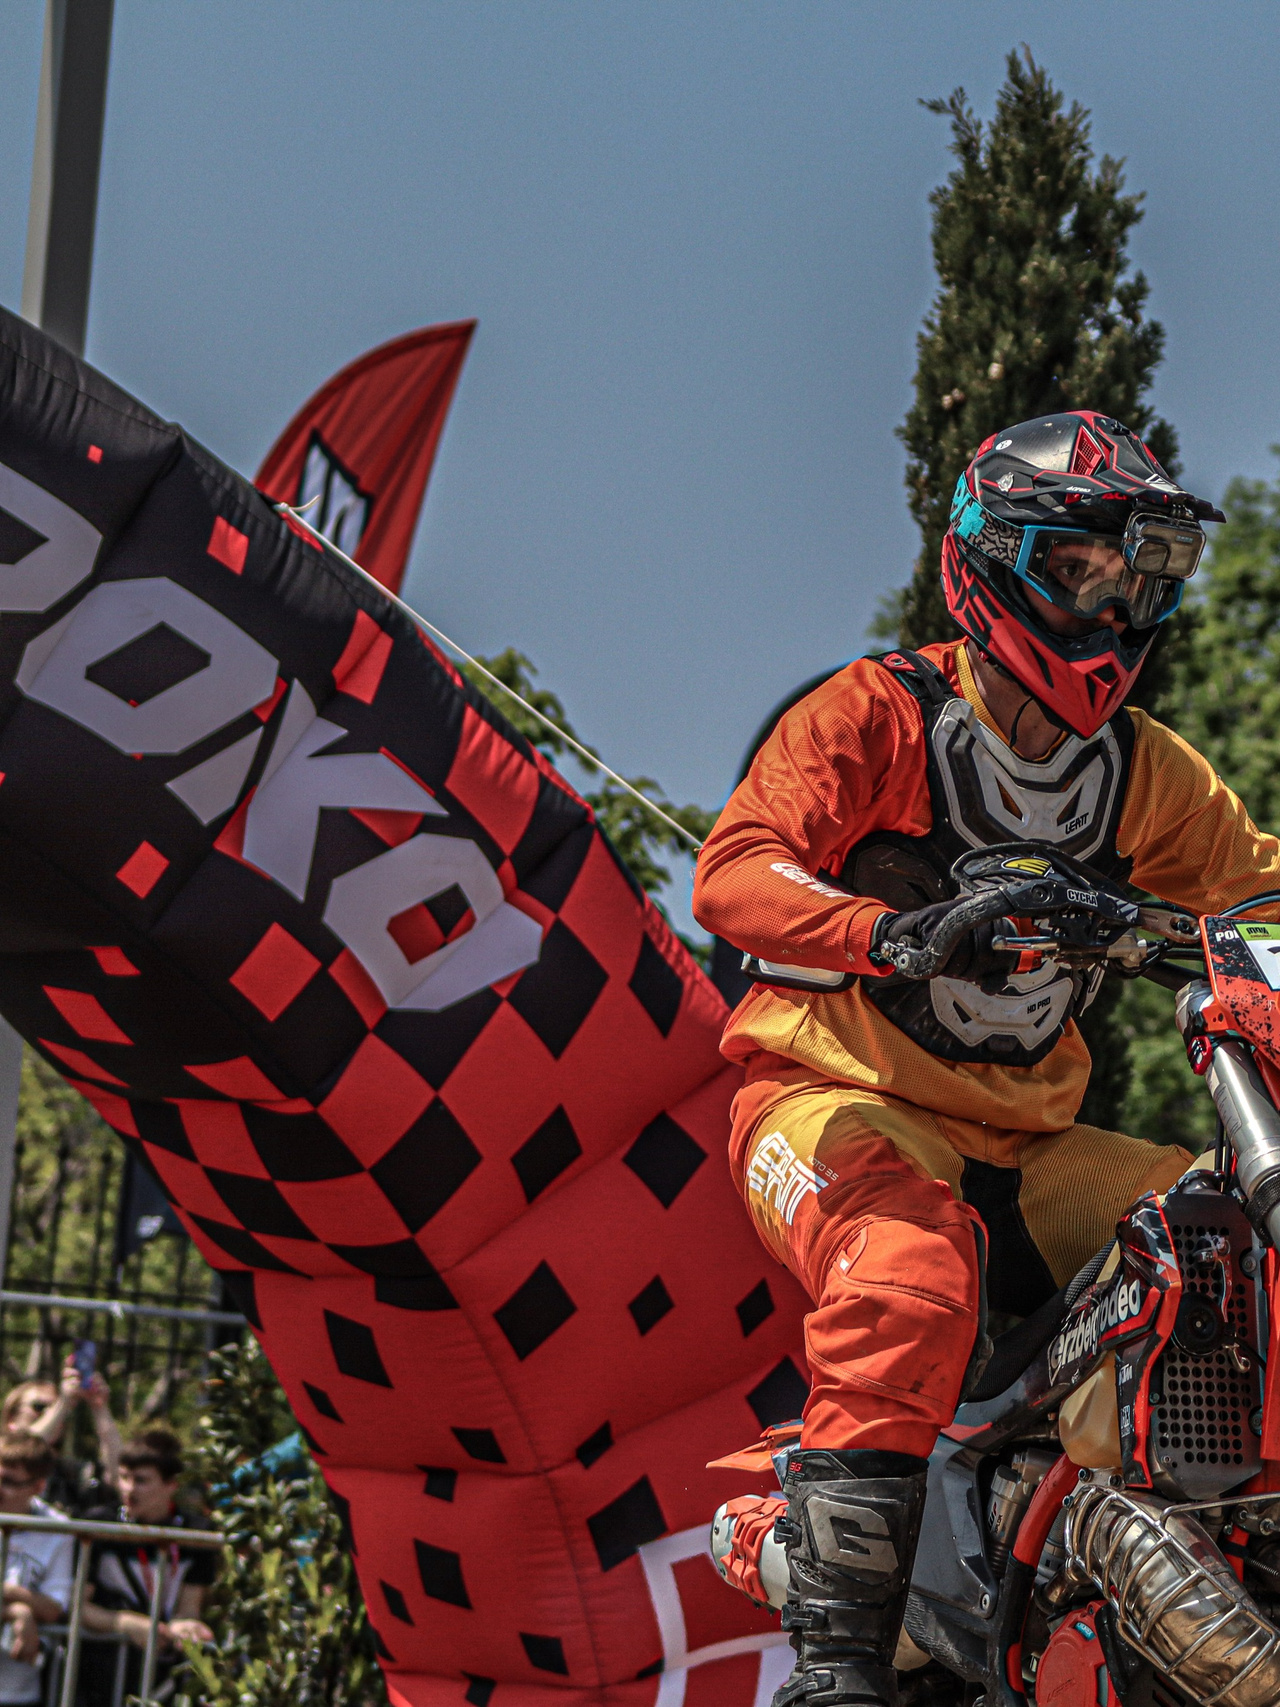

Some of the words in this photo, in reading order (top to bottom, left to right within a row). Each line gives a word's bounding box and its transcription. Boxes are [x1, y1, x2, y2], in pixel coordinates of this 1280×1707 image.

[1065, 812, 1089, 835] LEATT
[1067, 889, 1098, 907] CYCRA
[1027, 1004, 1036, 1014] HD
[1037, 996, 1051, 1009] PRO
